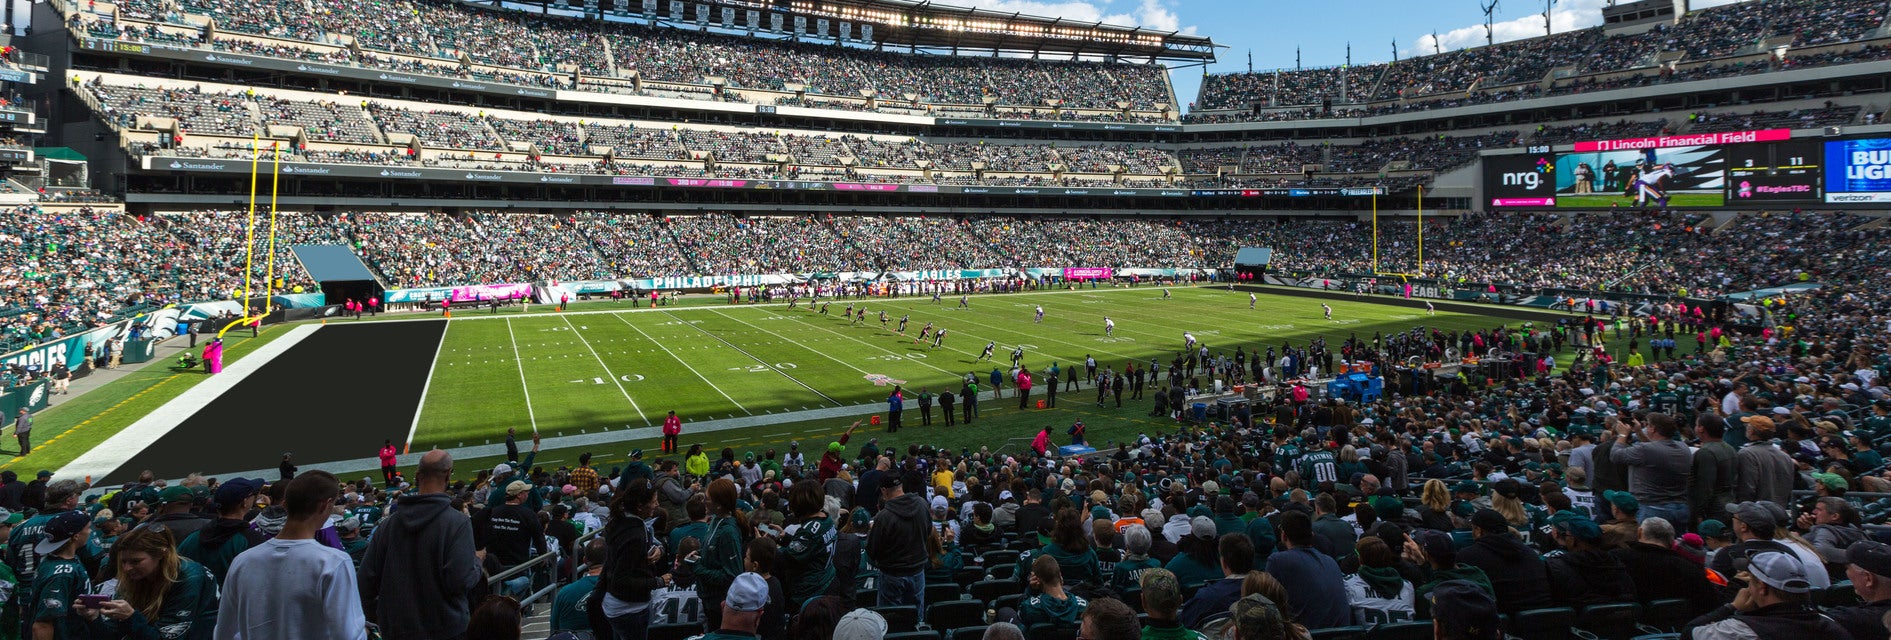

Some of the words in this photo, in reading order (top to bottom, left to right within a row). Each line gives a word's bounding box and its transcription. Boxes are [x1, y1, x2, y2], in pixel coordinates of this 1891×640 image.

[103, 43, 113, 52] 11
[120, 44, 141, 52] 15:00
[216, 55, 252, 65] Santander
[308, 66, 340, 74] Santander
[1612, 139, 1656, 150] Lincoln
[1659, 134, 1718, 147] Financial
[1722, 131, 1756, 144] Field
[1528, 146, 1549, 154] 15:00
[1744, 159, 1754, 167] 3
[1790, 156, 1803, 166] 11
[1852, 150, 1891, 166] BU
[183, 162, 224, 170] Santander
[1503, 172, 1539, 190] nrg
[1756, 185, 1810, 193] #EaglesTBC
[914, 270, 962, 280] EAGLES
[653, 275, 768, 289] PHILADELPHIA
[1412, 285, 1454, 299] EAGLS
[1314, 462, 1337, 482] 00
[54, 564, 73, 574] 25
[660, 598, 698, 623] 11
